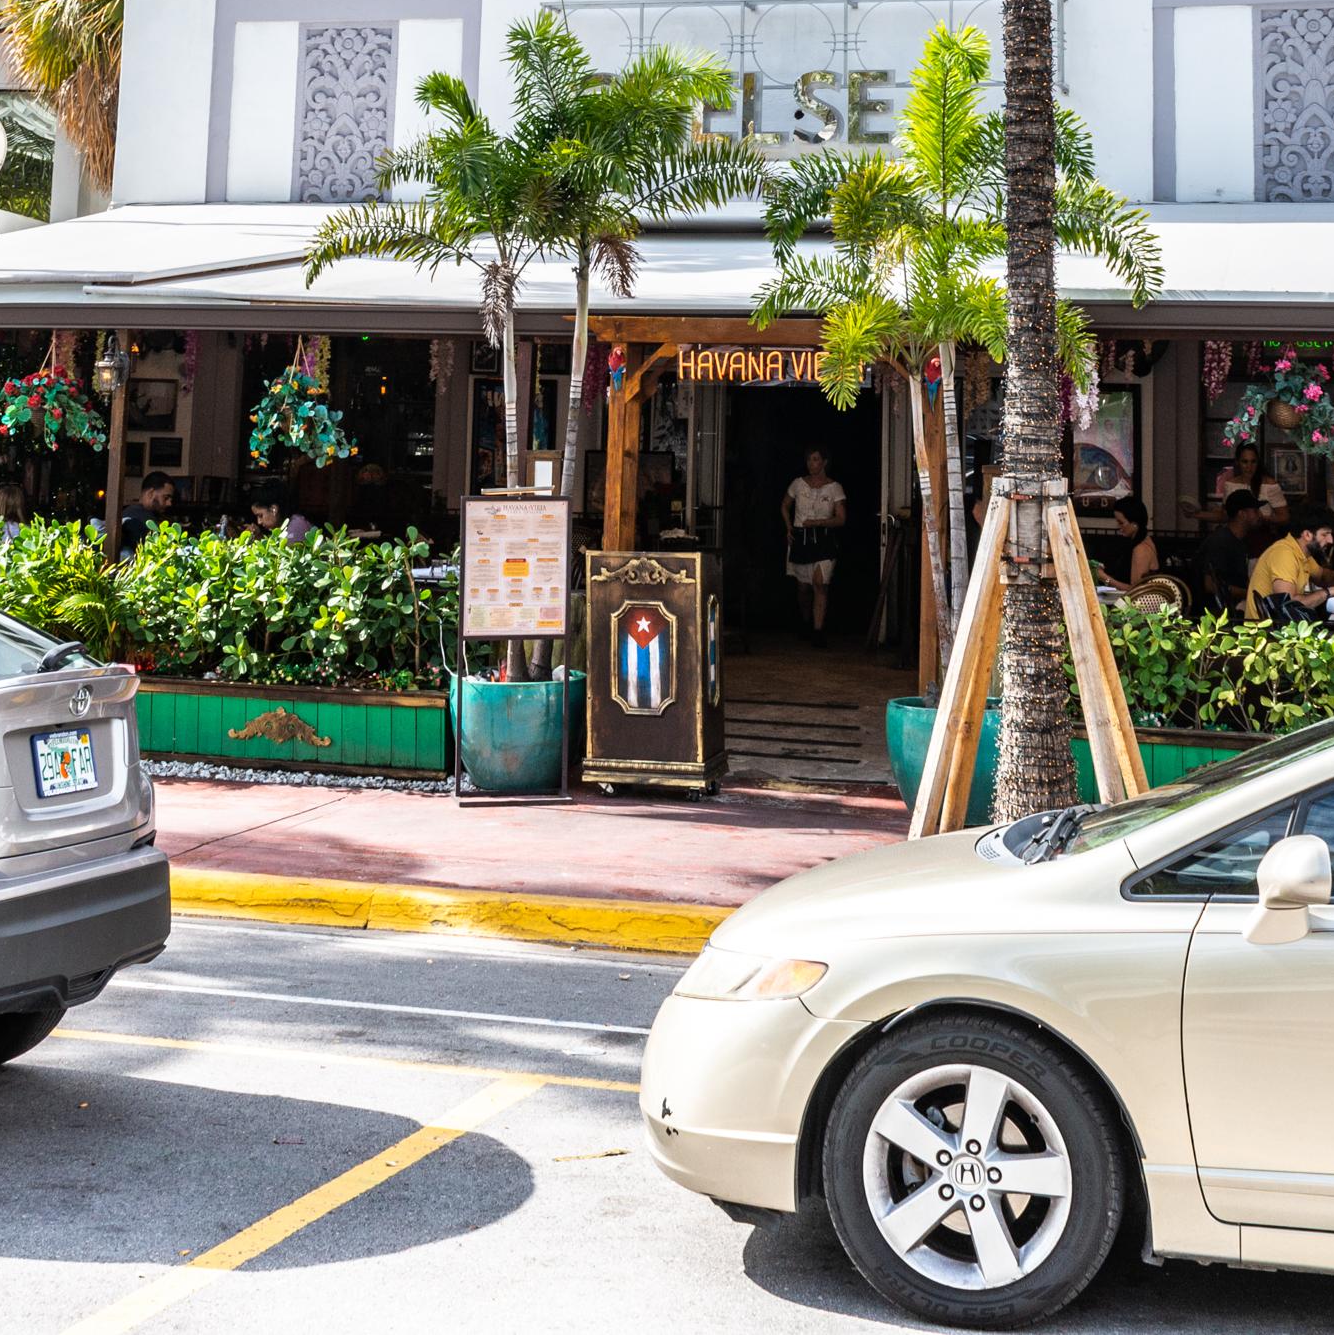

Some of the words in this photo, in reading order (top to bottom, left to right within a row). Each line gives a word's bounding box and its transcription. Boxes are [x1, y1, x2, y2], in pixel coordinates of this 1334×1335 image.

[678, 350, 783, 382] HAVANA
[791, 350, 864, 383] VIE
[931, 1035, 1047, 1080] COOPER
